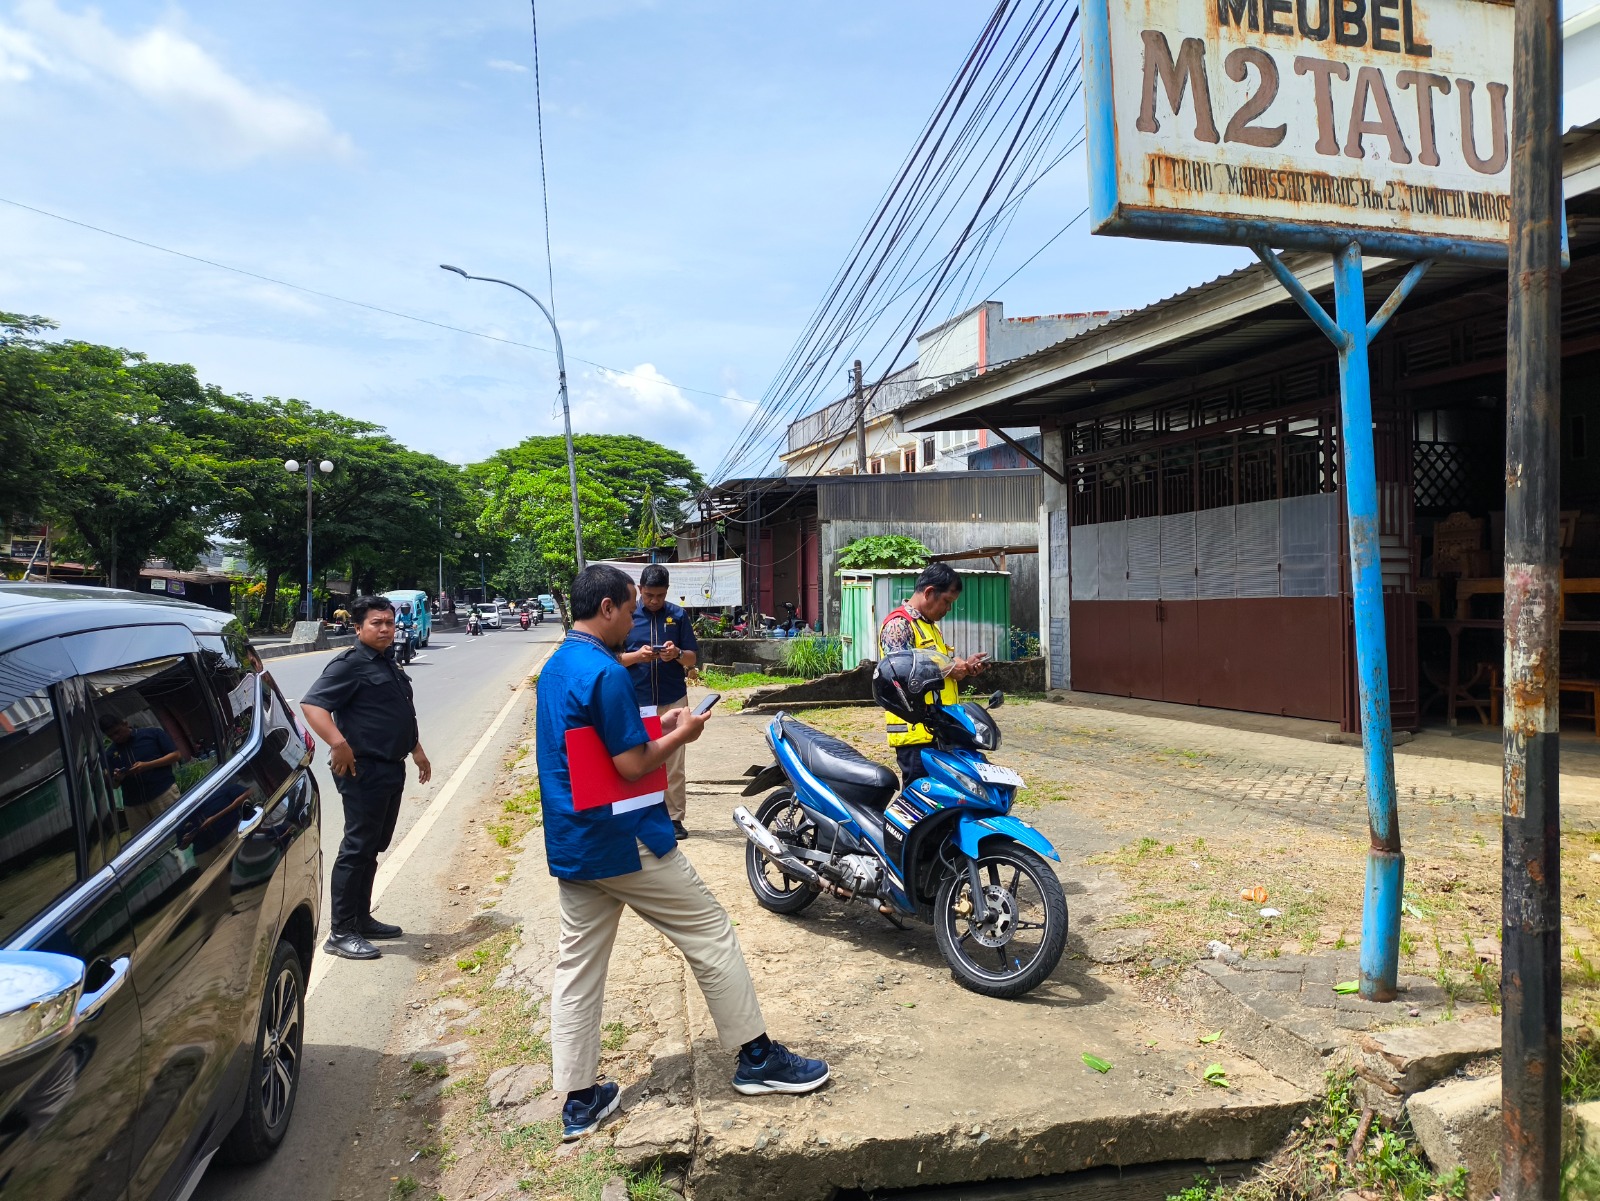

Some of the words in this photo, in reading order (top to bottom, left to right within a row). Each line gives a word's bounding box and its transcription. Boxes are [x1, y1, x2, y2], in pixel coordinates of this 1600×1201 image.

[1218, 0, 1433, 57] MEUBEL
[1310, 174, 1359, 207] MAROS
[1468, 192, 1510, 222] MAROS
[885, 822, 904, 842] YAMAHA
